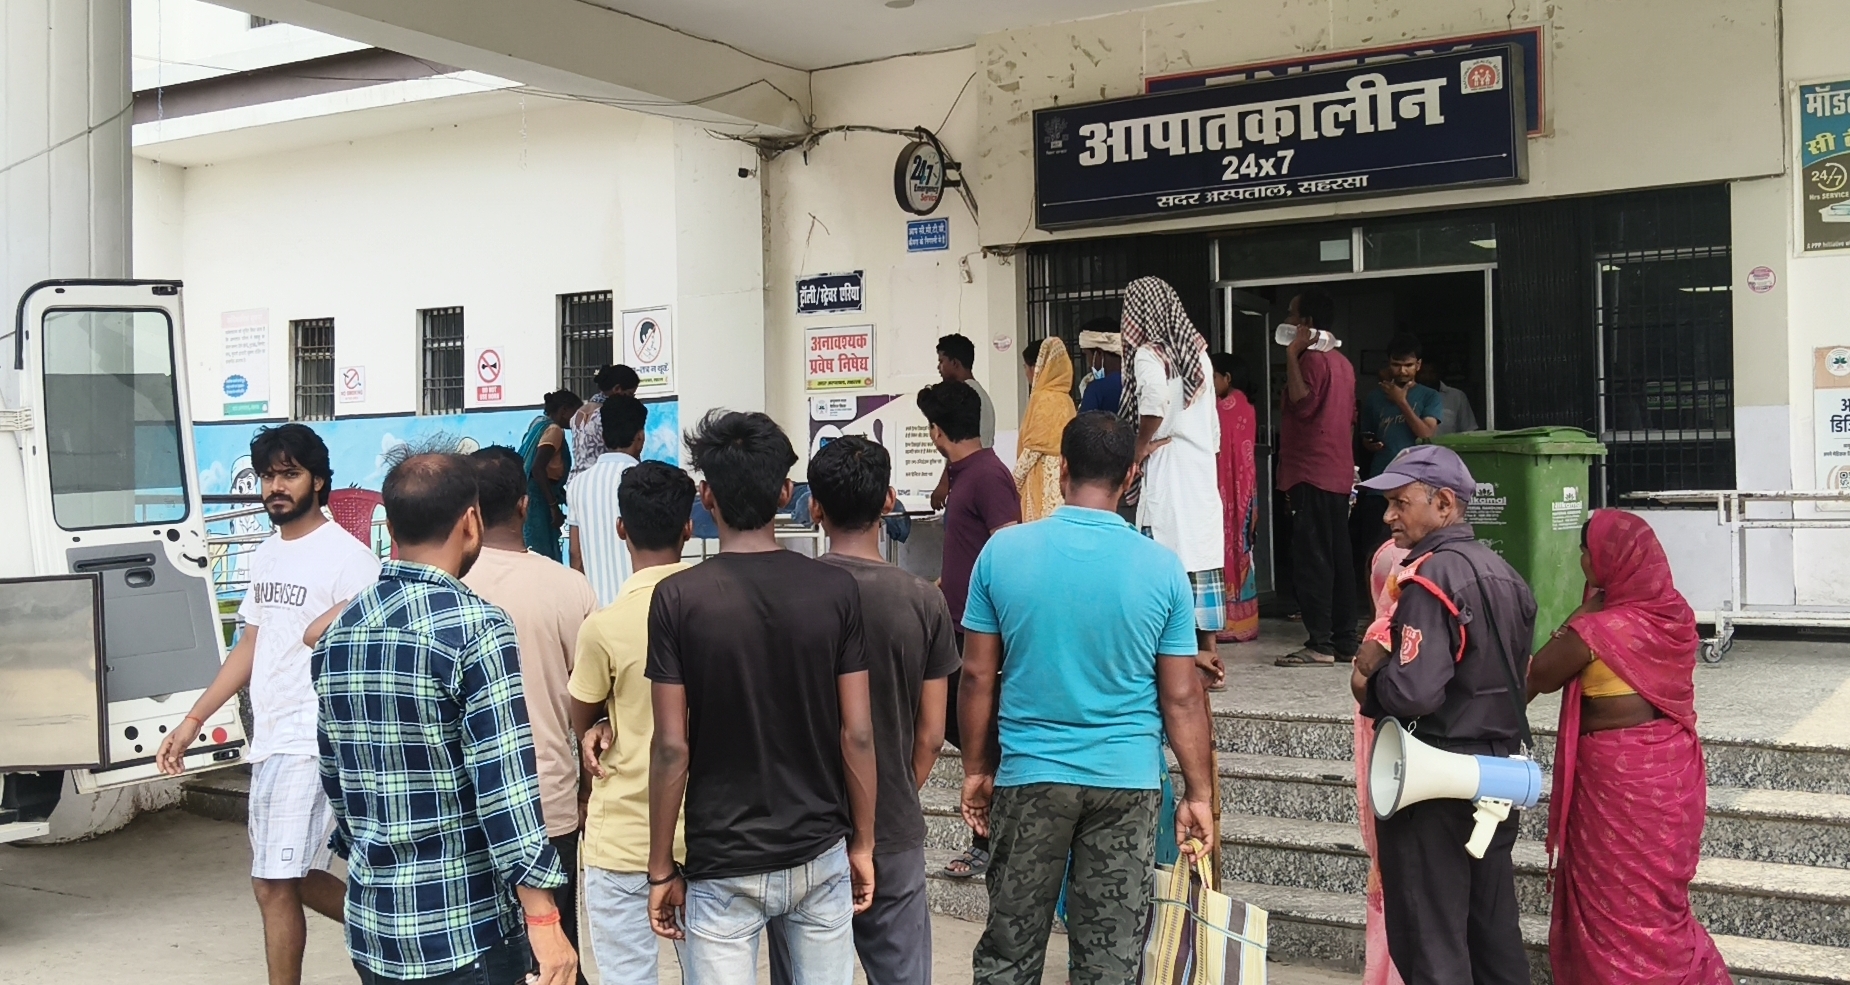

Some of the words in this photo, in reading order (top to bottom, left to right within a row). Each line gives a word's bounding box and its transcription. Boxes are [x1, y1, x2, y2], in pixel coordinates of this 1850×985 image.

[1805, 85, 1850, 118] मॉड
[1078, 73, 1447, 167] आपातकालीन
[1222, 149, 1296, 182] 24x7
[1811, 167, 1843, 186] 24/7
[914, 183, 939, 195] Emergency
[1156, 192, 1200, 208] सदर
[1204, 182, 1293, 204] अस्पताल,
[1297, 174, 1369, 194] सहरसा
[1822, 191, 1850, 201] SERVICE
[839, 282, 860, 302] एरिया
[810, 333, 868, 351] अनावश्यक
[1469, 496, 1507, 506] lkamal
